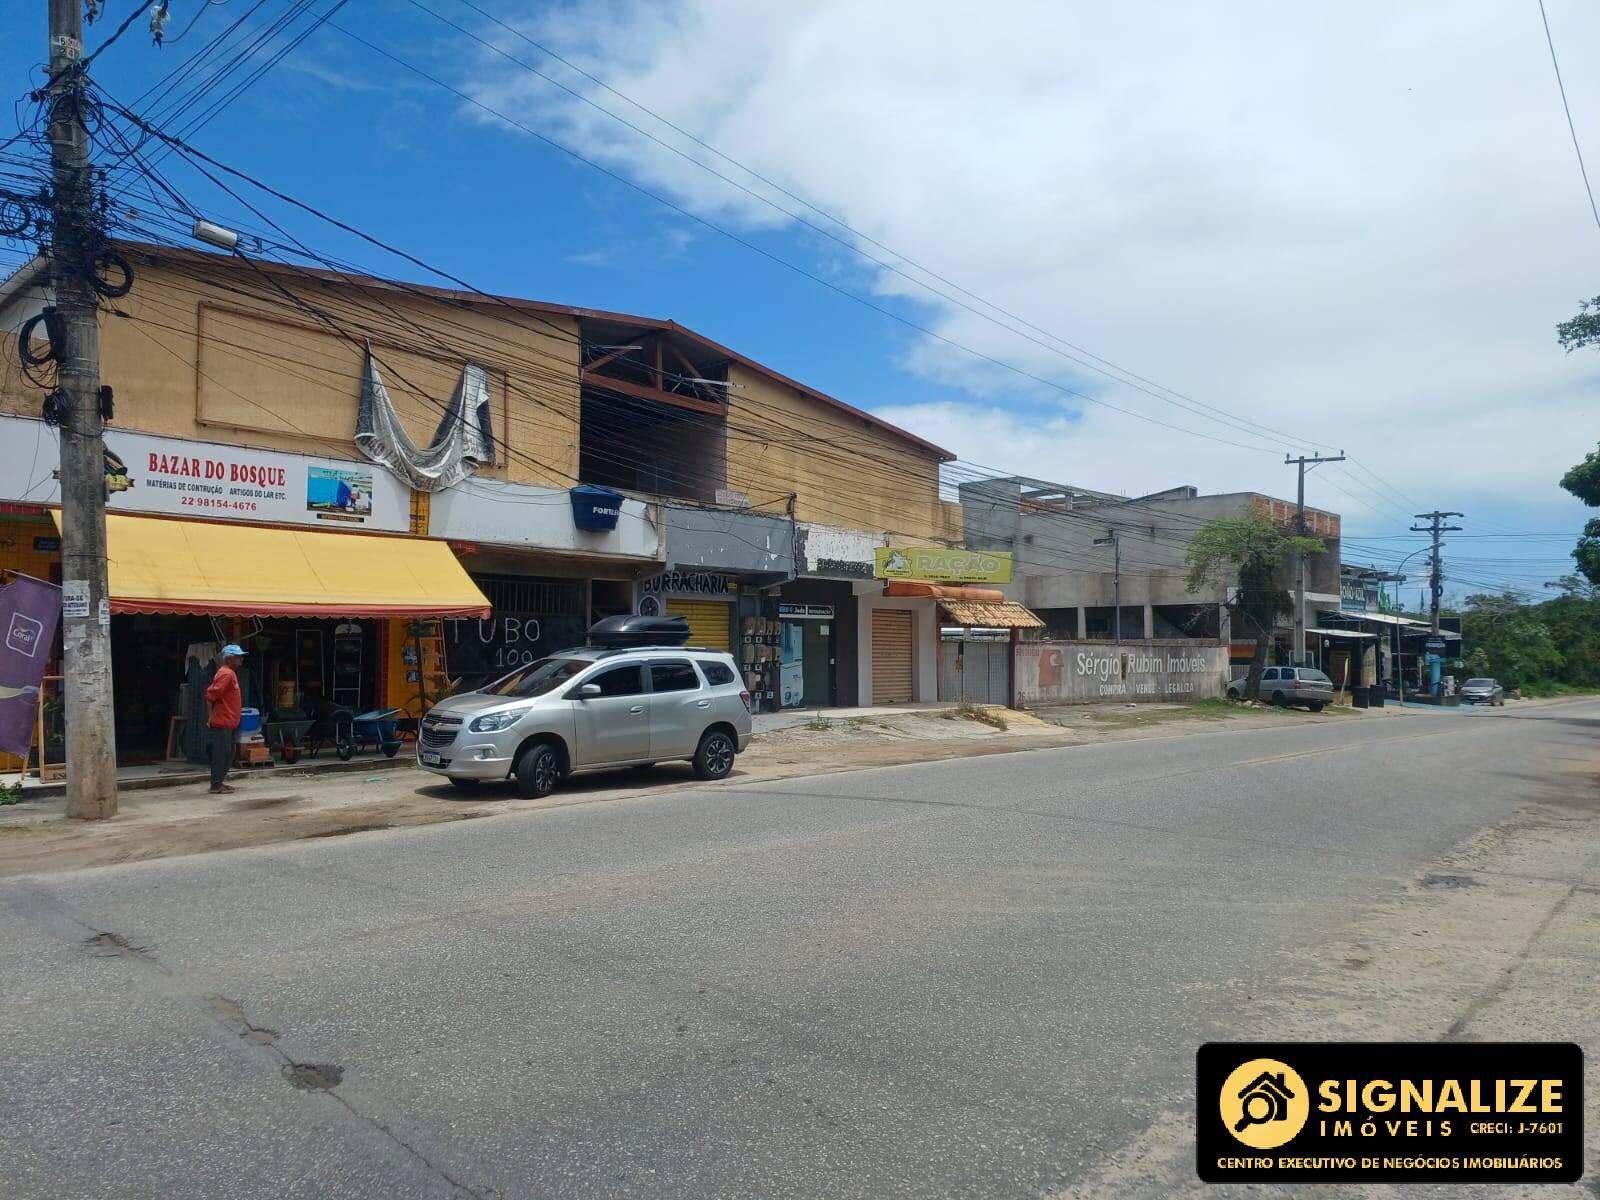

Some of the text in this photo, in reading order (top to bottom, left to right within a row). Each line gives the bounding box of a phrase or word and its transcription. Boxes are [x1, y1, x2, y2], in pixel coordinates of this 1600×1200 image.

[148, 452, 286, 488] BAZAR DO BOSQUE
[178, 482, 187, 491] DE
[229, 487, 254, 497] ARTIGOS
[254, 490, 263, 498] DO
[263, 491, 274, 499] LAR
[274, 492, 288, 500] ETC.
[181, 496, 257, 511] 22 98154-4676
[916, 553, 1001, 575] RAÇÃO
[443, 617, 541, 643] TUBO
[495, 648, 533, 667] 100
[1077, 652, 1206, 681] Sérgio Rubim Imóveis
[1100, 684, 1127, 696] COMPRA
[1164, 682, 1195, 694] LEGALIZA
